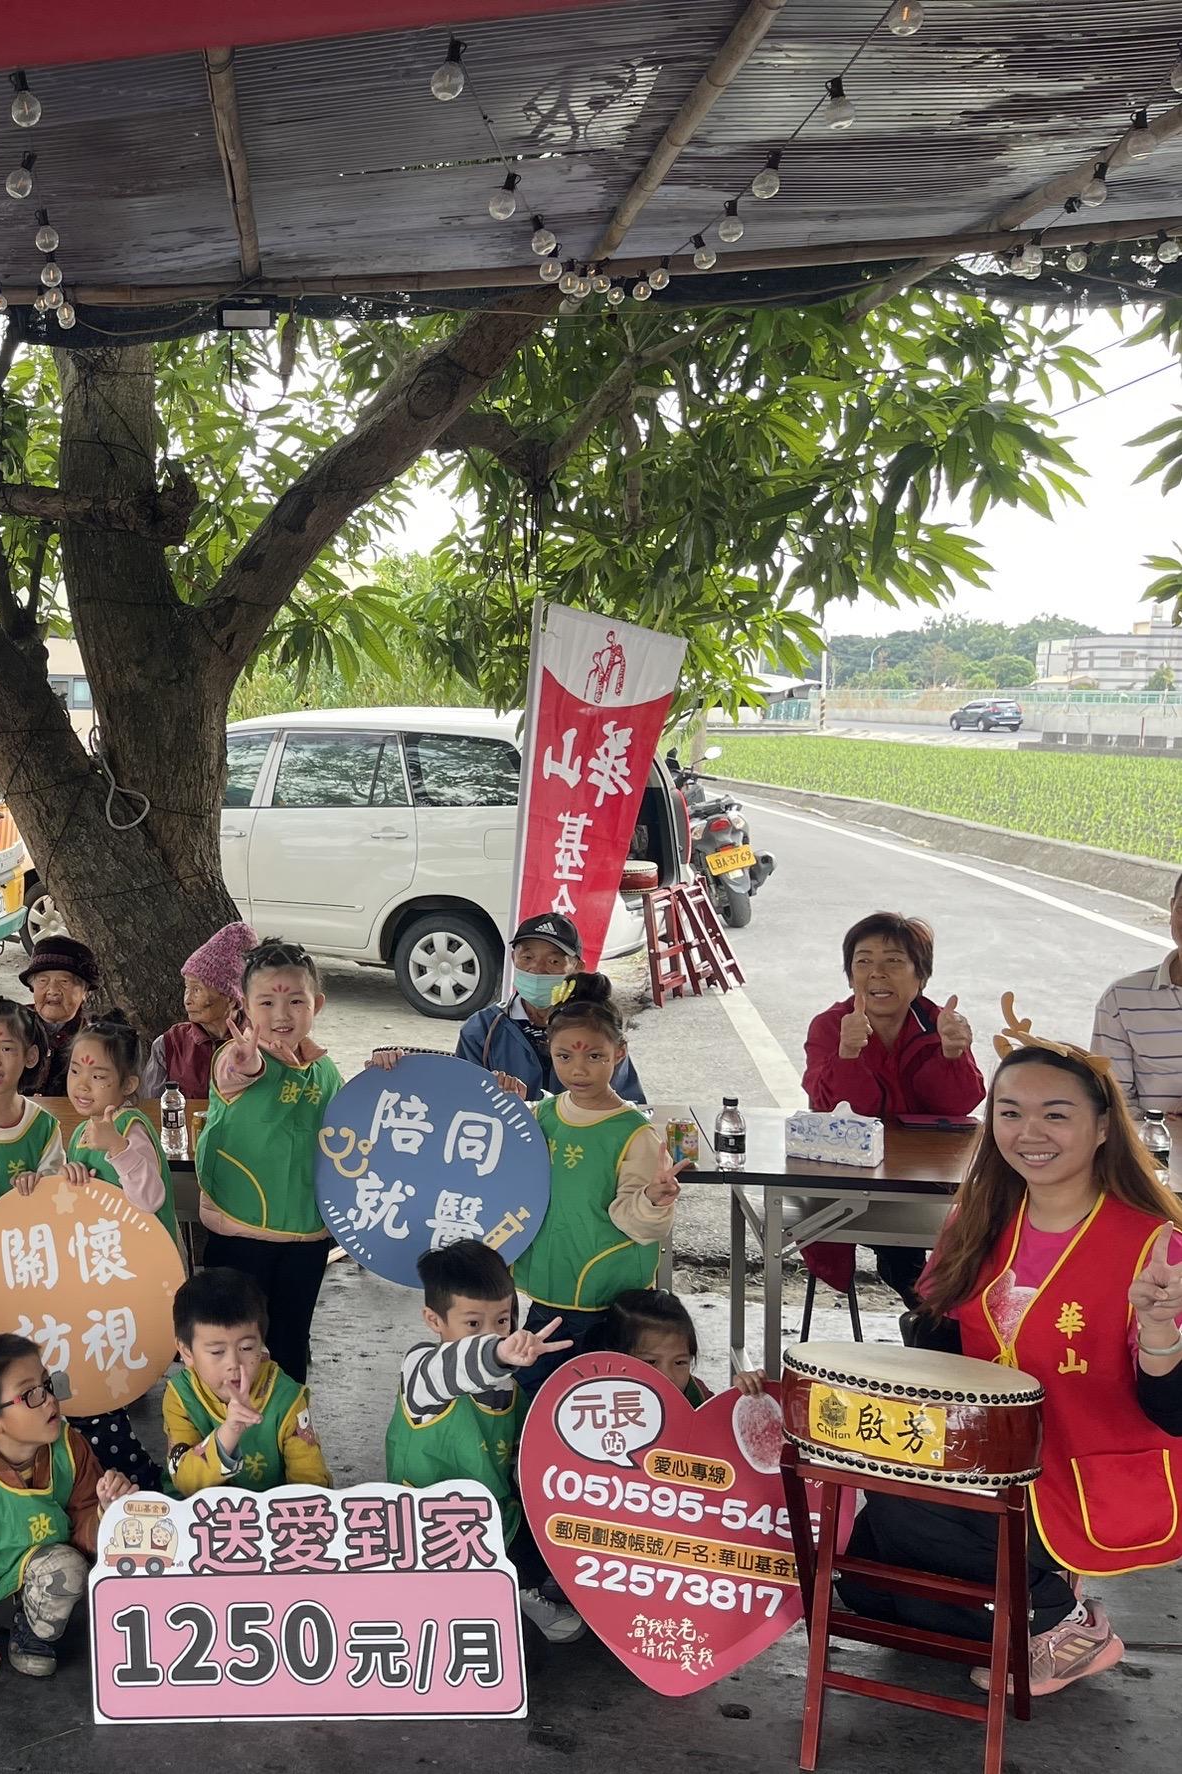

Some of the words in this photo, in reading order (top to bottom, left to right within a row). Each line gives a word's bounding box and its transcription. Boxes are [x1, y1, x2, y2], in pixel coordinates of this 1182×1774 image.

[278, 1080, 323, 1105] 啟芳
[369, 1089, 505, 1176] 陪同
[346, 1172, 486, 1250] 就醫
[1, 1218, 138, 1290] 關懷
[1054, 1301, 1088, 1375] 華山
[570, 1390, 647, 1431] 元長
[817, 1422, 851, 1440] Chifan
[856, 1403, 934, 1454] 啟芳
[604, 1433, 625, 1454] 站
[653, 1455, 727, 1485] 愛心專線
[126, 1502, 168, 1514] 華山基金會
[189, 1493, 496, 1574] 送愛到家
[554, 1519, 798, 1578] 郵局劃撥帳號/戶名:華山基金
[574, 1555, 783, 1618] 22573817
[632, 1612, 697, 1642] 當我變老
[641, 1637, 715, 1676] 請你愛我
